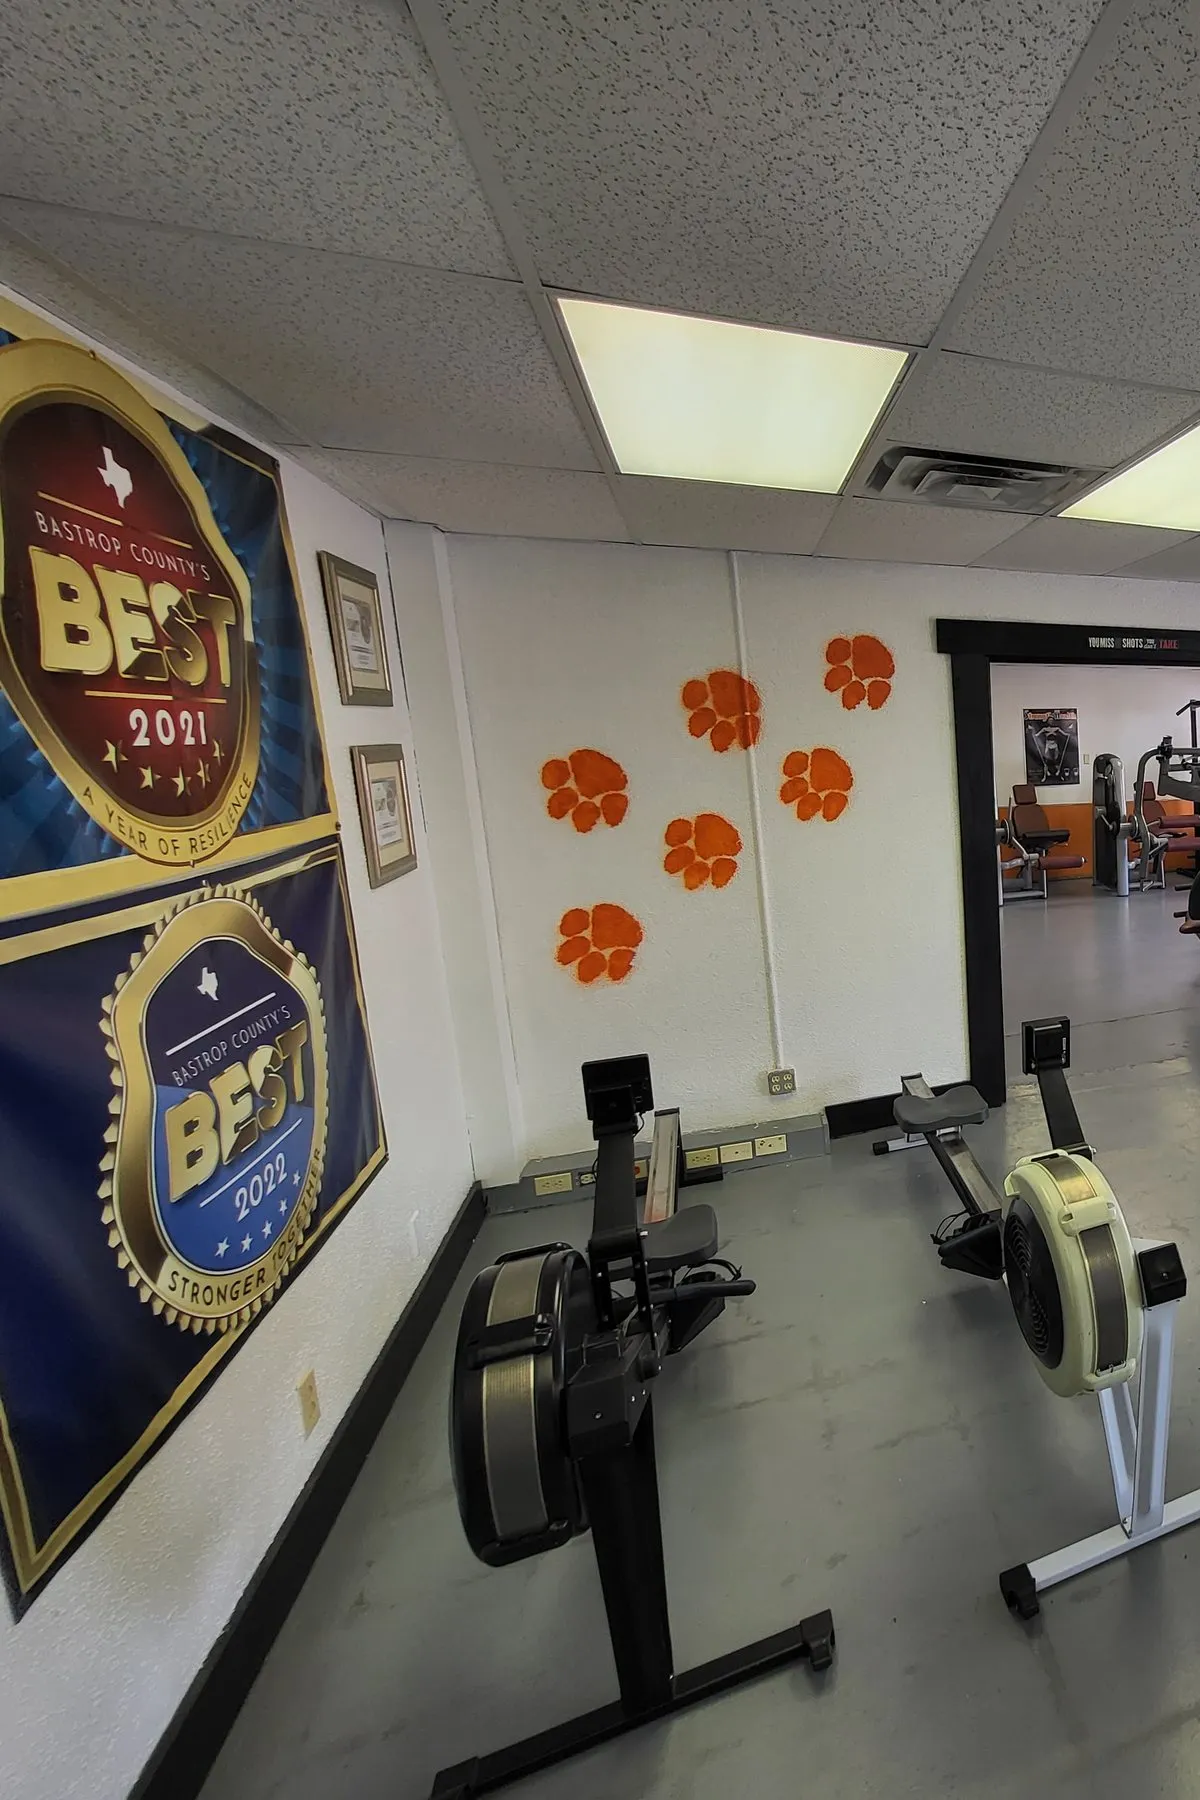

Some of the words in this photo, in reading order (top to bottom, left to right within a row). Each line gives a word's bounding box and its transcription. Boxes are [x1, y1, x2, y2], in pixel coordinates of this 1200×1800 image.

[34, 510, 121, 555] BASTROP
[130, 543, 211, 581] COUNTY'S
[28, 545, 236, 688] BEST
[1088, 636, 1100, 648] YOU
[1100, 637, 1115, 649] MISS
[1122, 638, 1143, 649] SHOTS
[129, 708, 207, 747] 2021
[83, 786, 95, 805] A
[106, 803, 149, 851] YEAR
[158, 837, 181, 857] OF
[188, 772, 252, 855] RESILIENCE
[172, 1042, 228, 1087] BASTROP
[231, 1005, 291, 1049] COUNTY'S
[165, 1020, 307, 1203] BEST
[168, 1267, 266, 1306] STRONGER
[272, 1147, 321, 1272] TOGETHER
[235, 1152, 288, 1222] 2022
